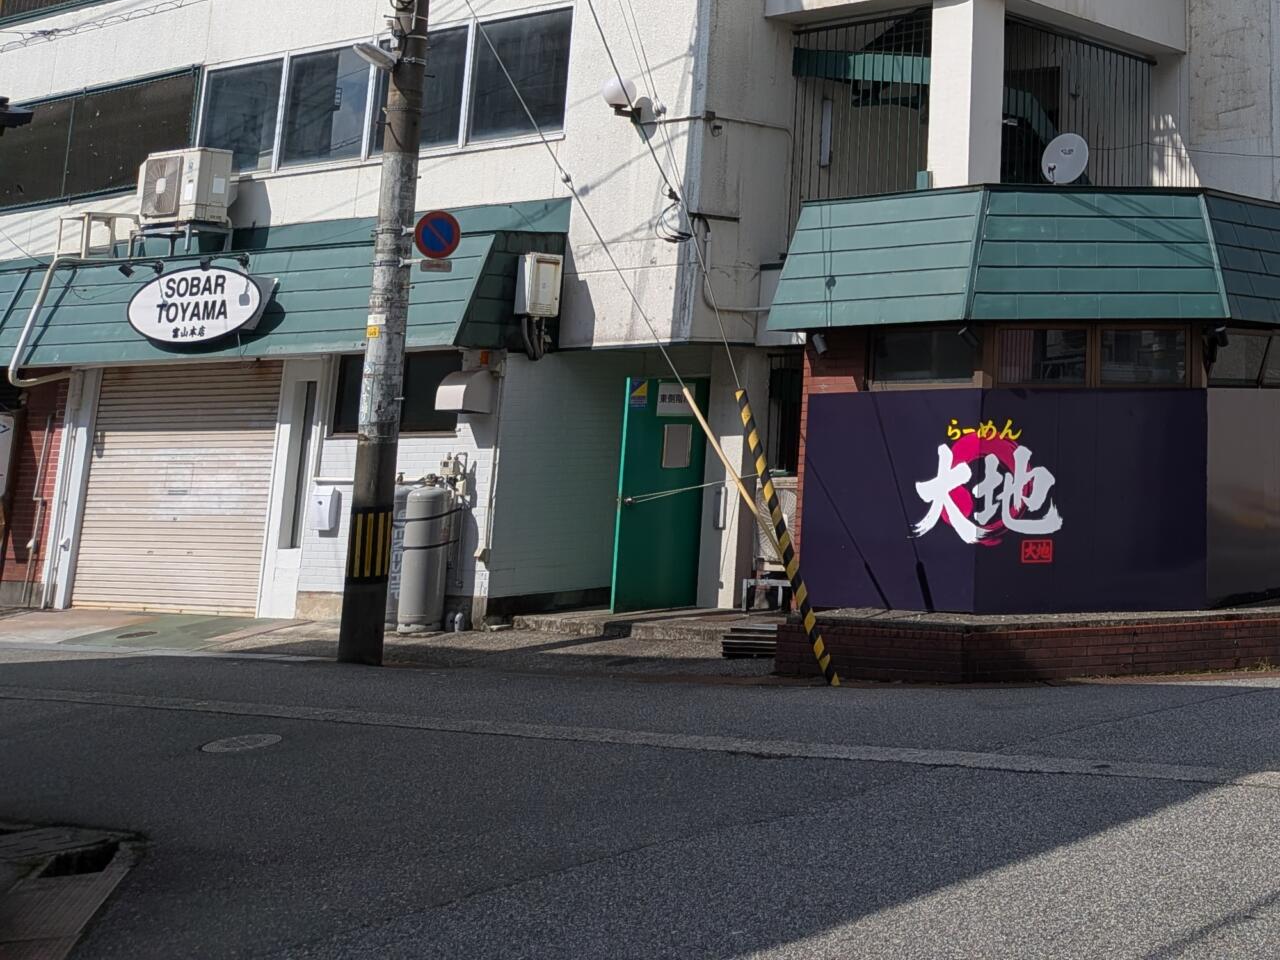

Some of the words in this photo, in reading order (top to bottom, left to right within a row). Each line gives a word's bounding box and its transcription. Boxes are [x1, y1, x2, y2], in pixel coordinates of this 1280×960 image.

[164, 274, 227, 299] SOBAR
[156, 299, 228, 323] TOYAMA
[172, 326, 206, 339] 富山本店
[947, 419, 1023, 441] らーめん
[907, 443, 1064, 544] 大地
[1024, 542, 1052, 559] 大地
